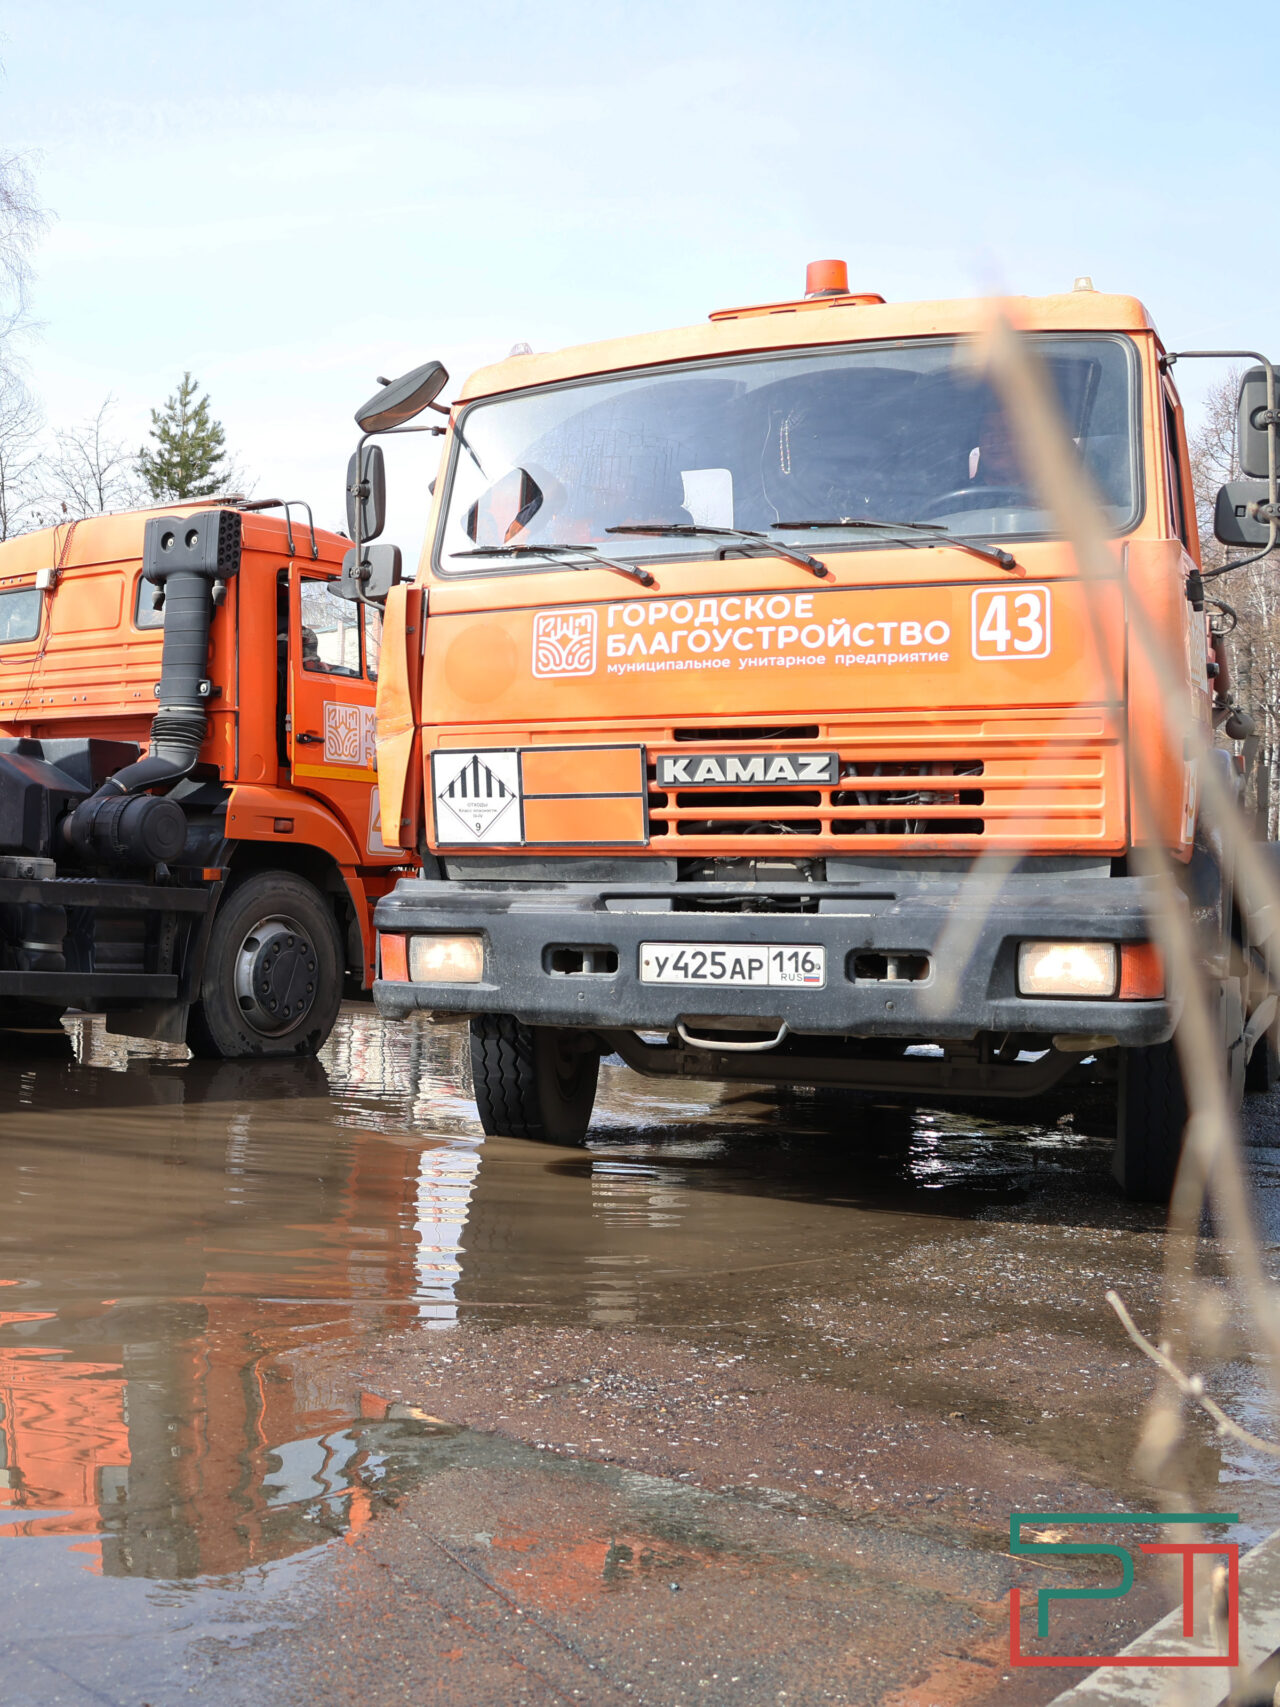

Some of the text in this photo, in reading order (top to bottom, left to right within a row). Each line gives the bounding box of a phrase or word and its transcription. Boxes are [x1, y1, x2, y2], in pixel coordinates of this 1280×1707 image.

[607, 594, 814, 628] ГОРОДСКОЕ
[979, 593, 1043, 652] 43
[606, 617, 950, 657] БЛАГОУСТРОЙСТВО
[607, 651, 949, 675] муниципальное унитарное предприятие
[663, 756, 831, 782] KAMAZ
[475, 822, 481, 831] 9
[655, 951, 816, 980] У425АР 116
[780, 973, 803, 982] RUS
